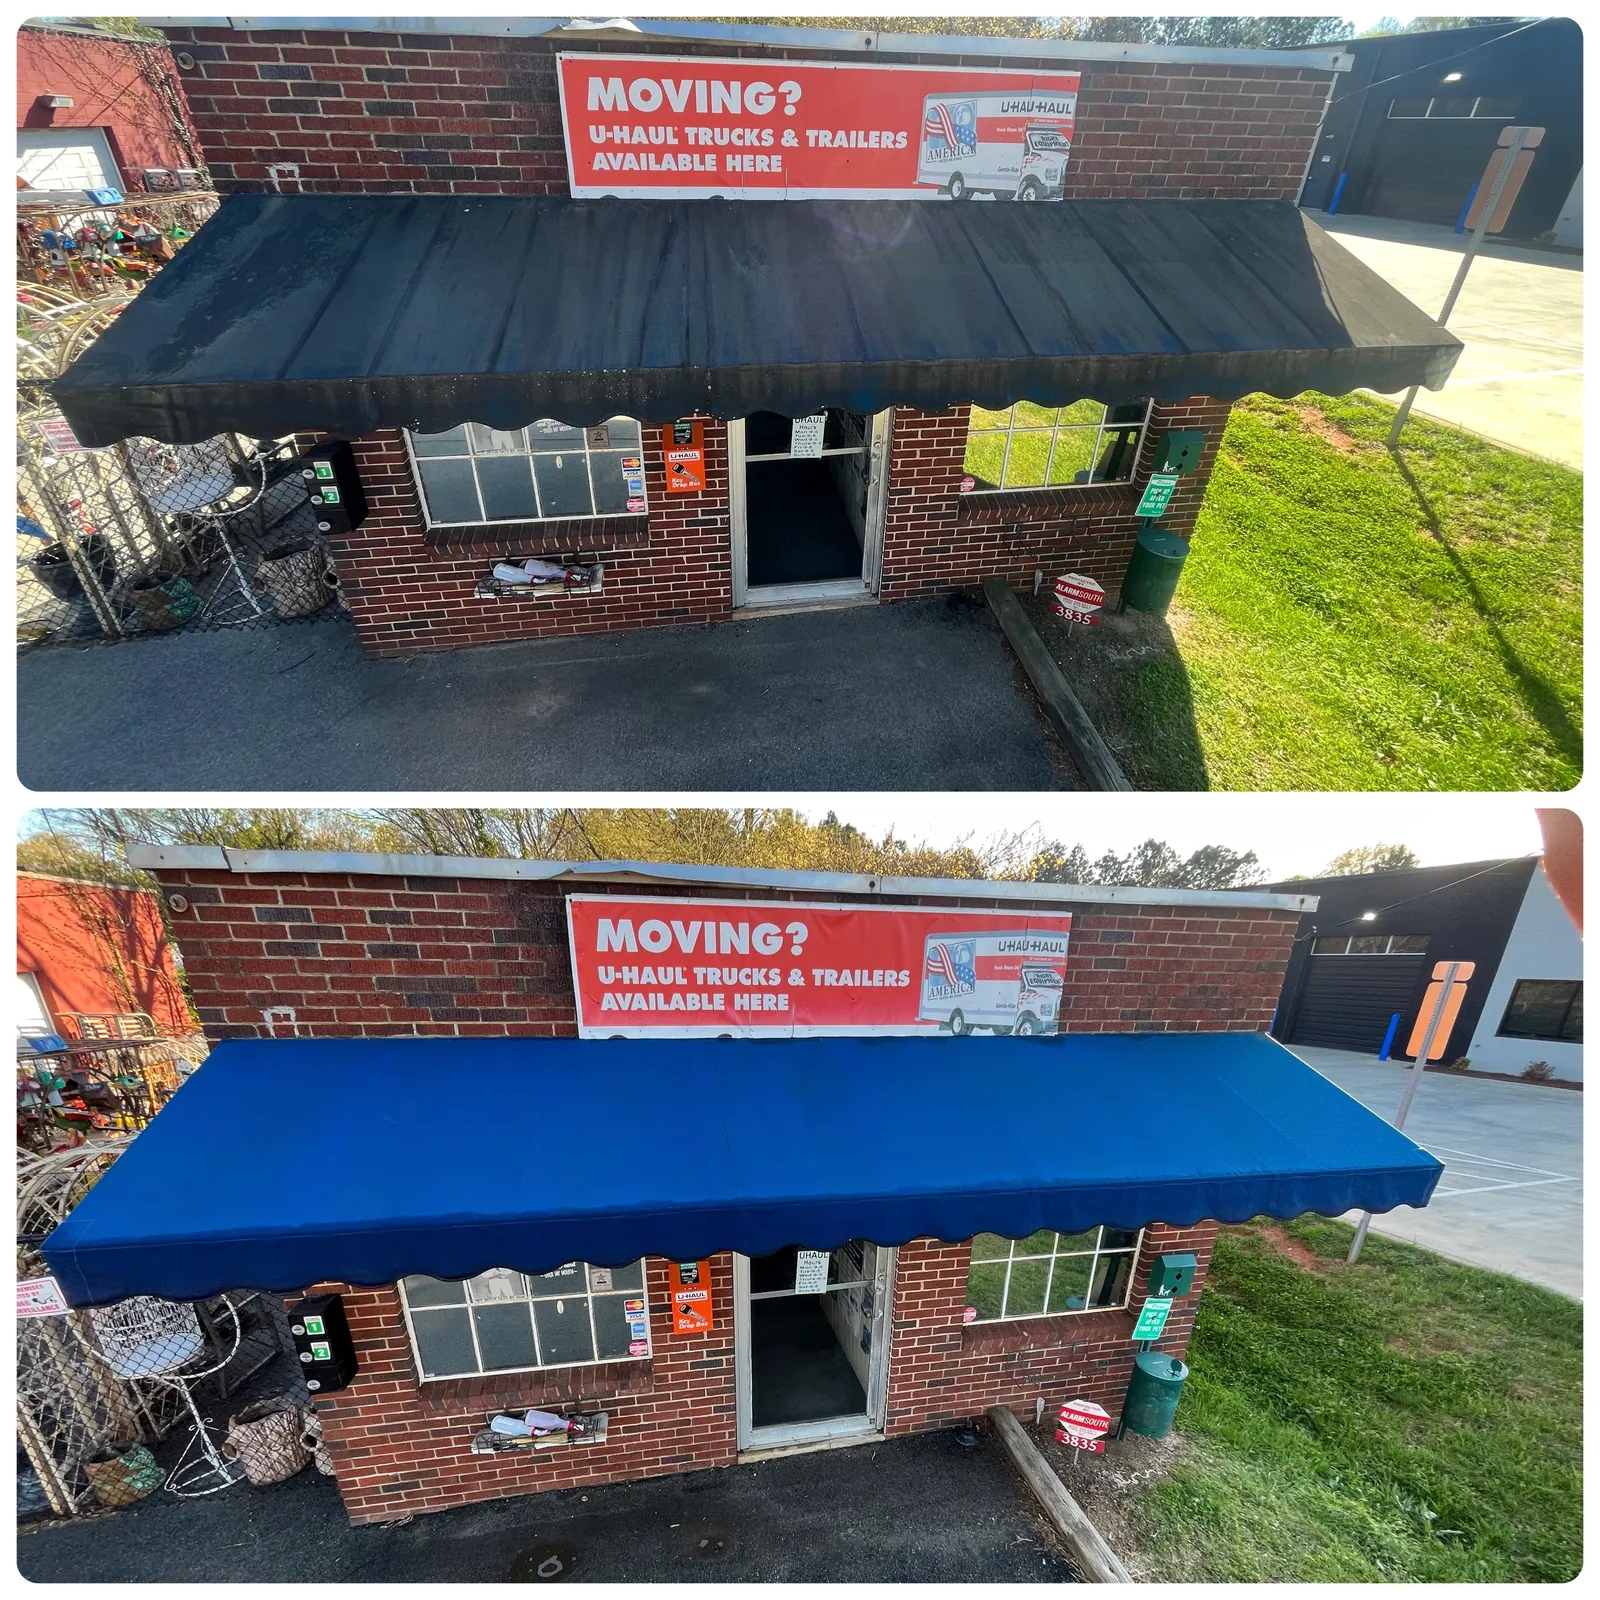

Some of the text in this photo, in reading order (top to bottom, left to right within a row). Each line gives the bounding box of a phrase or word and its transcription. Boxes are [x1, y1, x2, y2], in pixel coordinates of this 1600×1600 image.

[587, 77, 802, 116] MOVING?
[589, 125, 908, 149] U-HAUL TRUCKS & TRAILERS
[927, 144, 975, 161] AMERICA
[592, 152, 782, 172] AVAILABLE HERE
[320, 468, 327, 476] 1
[327, 492, 335, 500] 2
[1055, 583, 1104, 603] ALARMSOUTH
[1055, 605, 1092, 625] 3835
[597, 918, 809, 956] MOVING?
[598, 965, 910, 987] U-HAUL TRUCKS & TRAILERS
[928, 981, 975, 998] AMERICA
[601, 993, 788, 1011] AVAILABLE HERE
[311, 1323, 318, 1331] 1
[317, 1349, 326, 1357] 2
[1060, 1410, 1109, 1428] ALARMSOUTH
[1061, 1433, 1098, 1451] 3835
